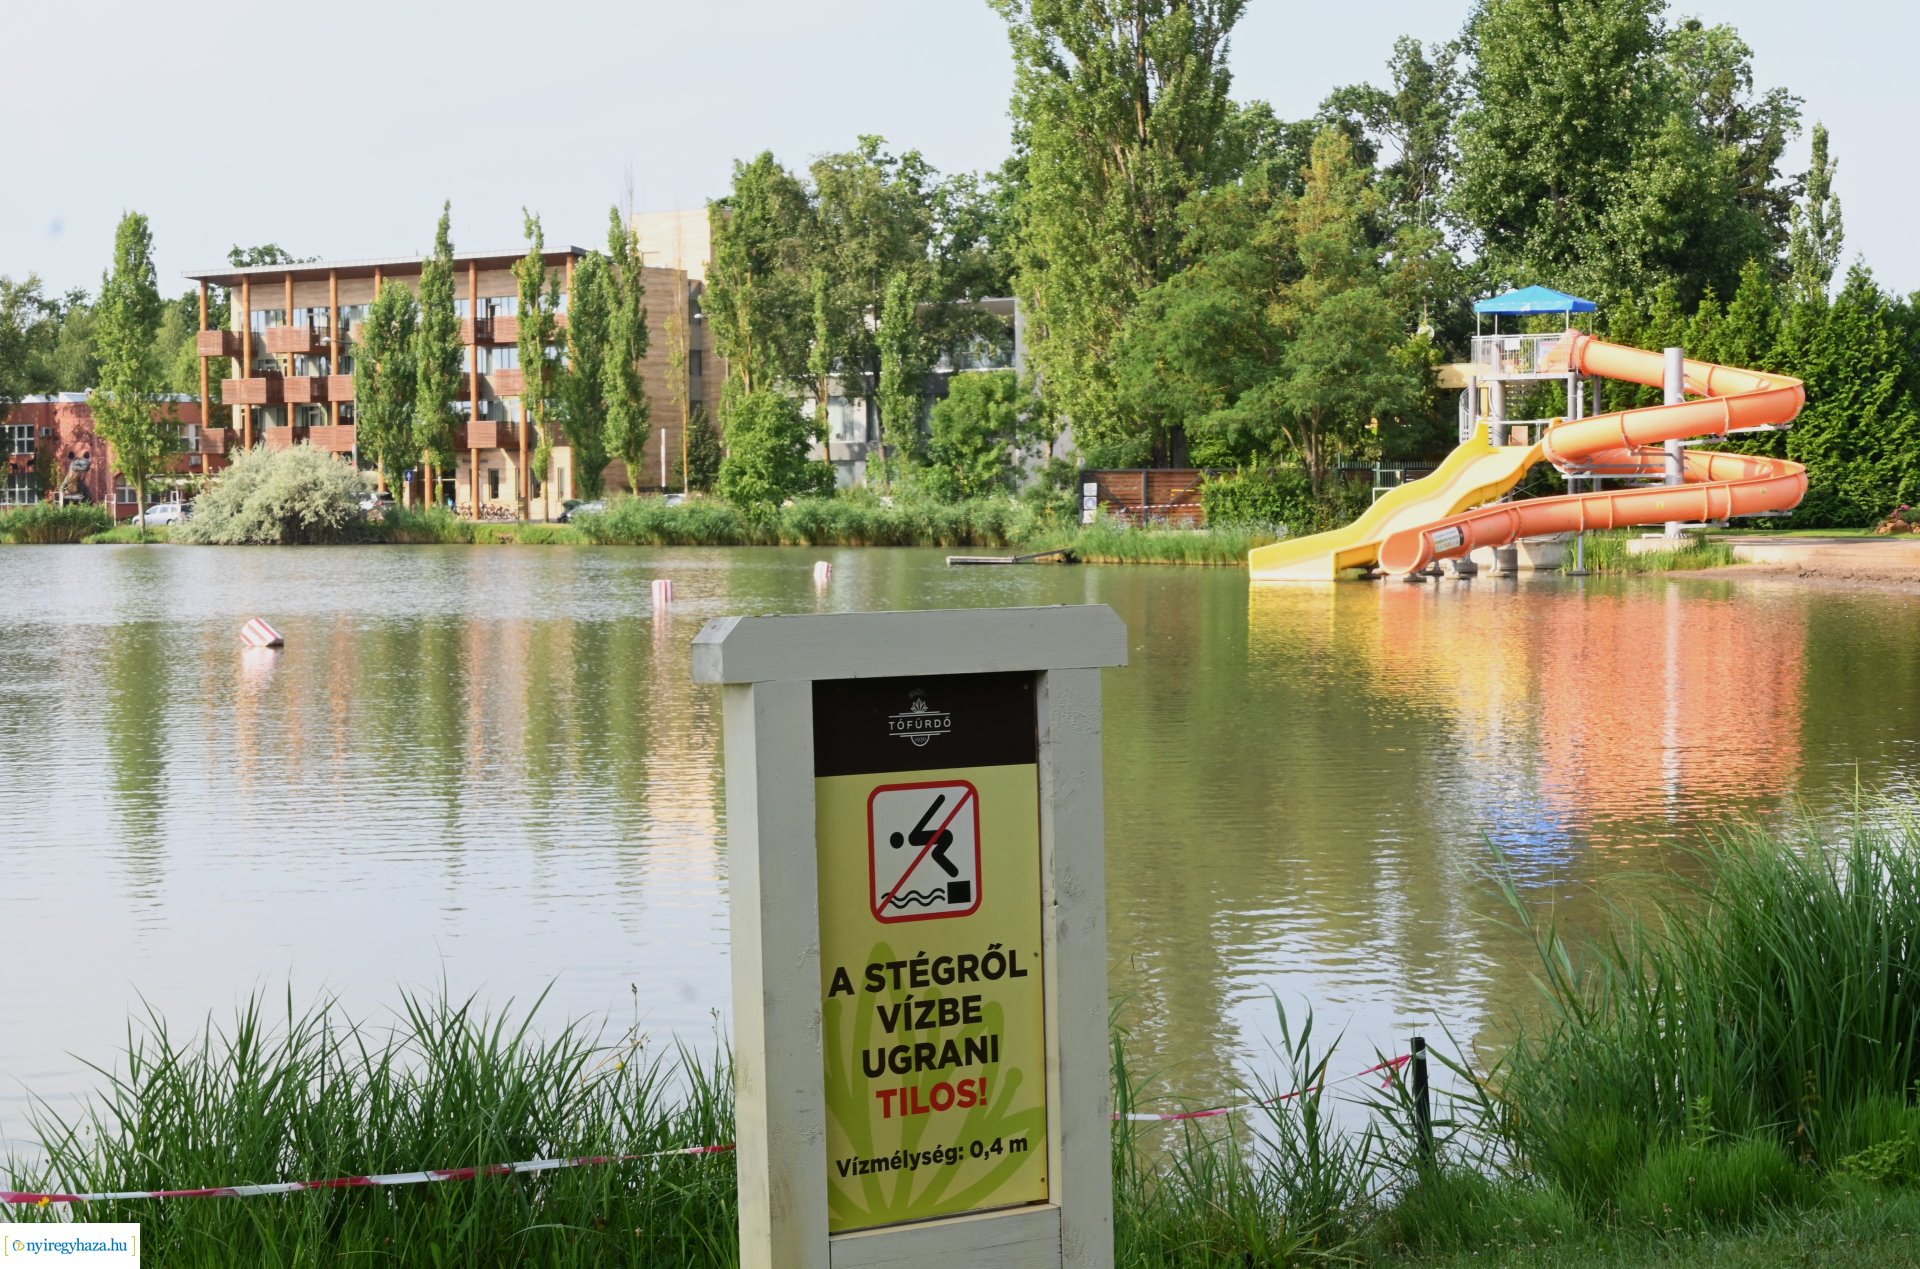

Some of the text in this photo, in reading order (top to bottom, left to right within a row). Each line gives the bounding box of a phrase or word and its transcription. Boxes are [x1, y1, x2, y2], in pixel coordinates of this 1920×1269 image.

[828, 943, 1028, 997] A STÉGRŐL
[877, 994, 983, 1034] VÍZBE
[862, 1034, 999, 1078] UGRANI
[876, 1077, 988, 1119] TILOS!
[836, 1137, 1028, 1178] Vízmélység: 0,4 m
